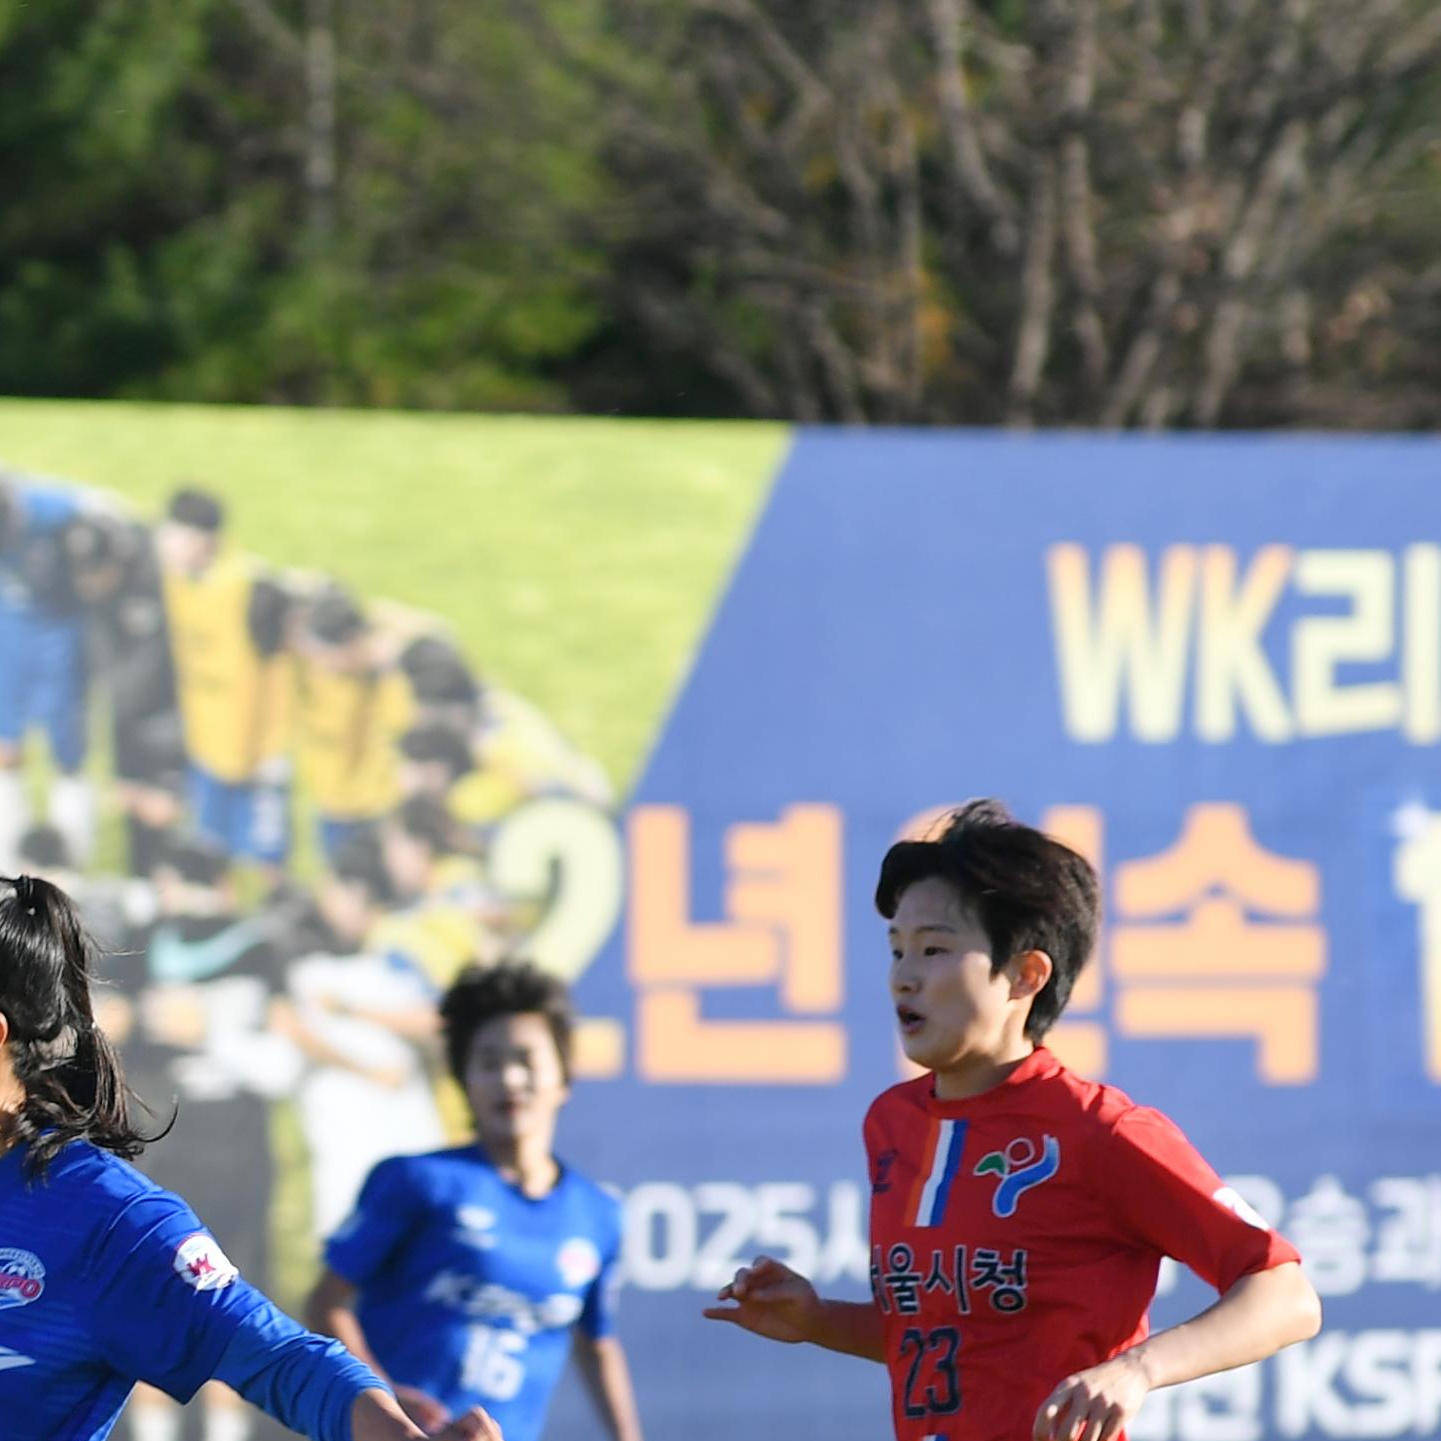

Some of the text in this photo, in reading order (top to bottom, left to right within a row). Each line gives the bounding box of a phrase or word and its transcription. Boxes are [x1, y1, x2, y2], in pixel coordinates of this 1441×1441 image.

[491, 797, 846, 1084] 2년
[460, 1323, 526, 1400] 16
[900, 1325, 963, 1421] 23
